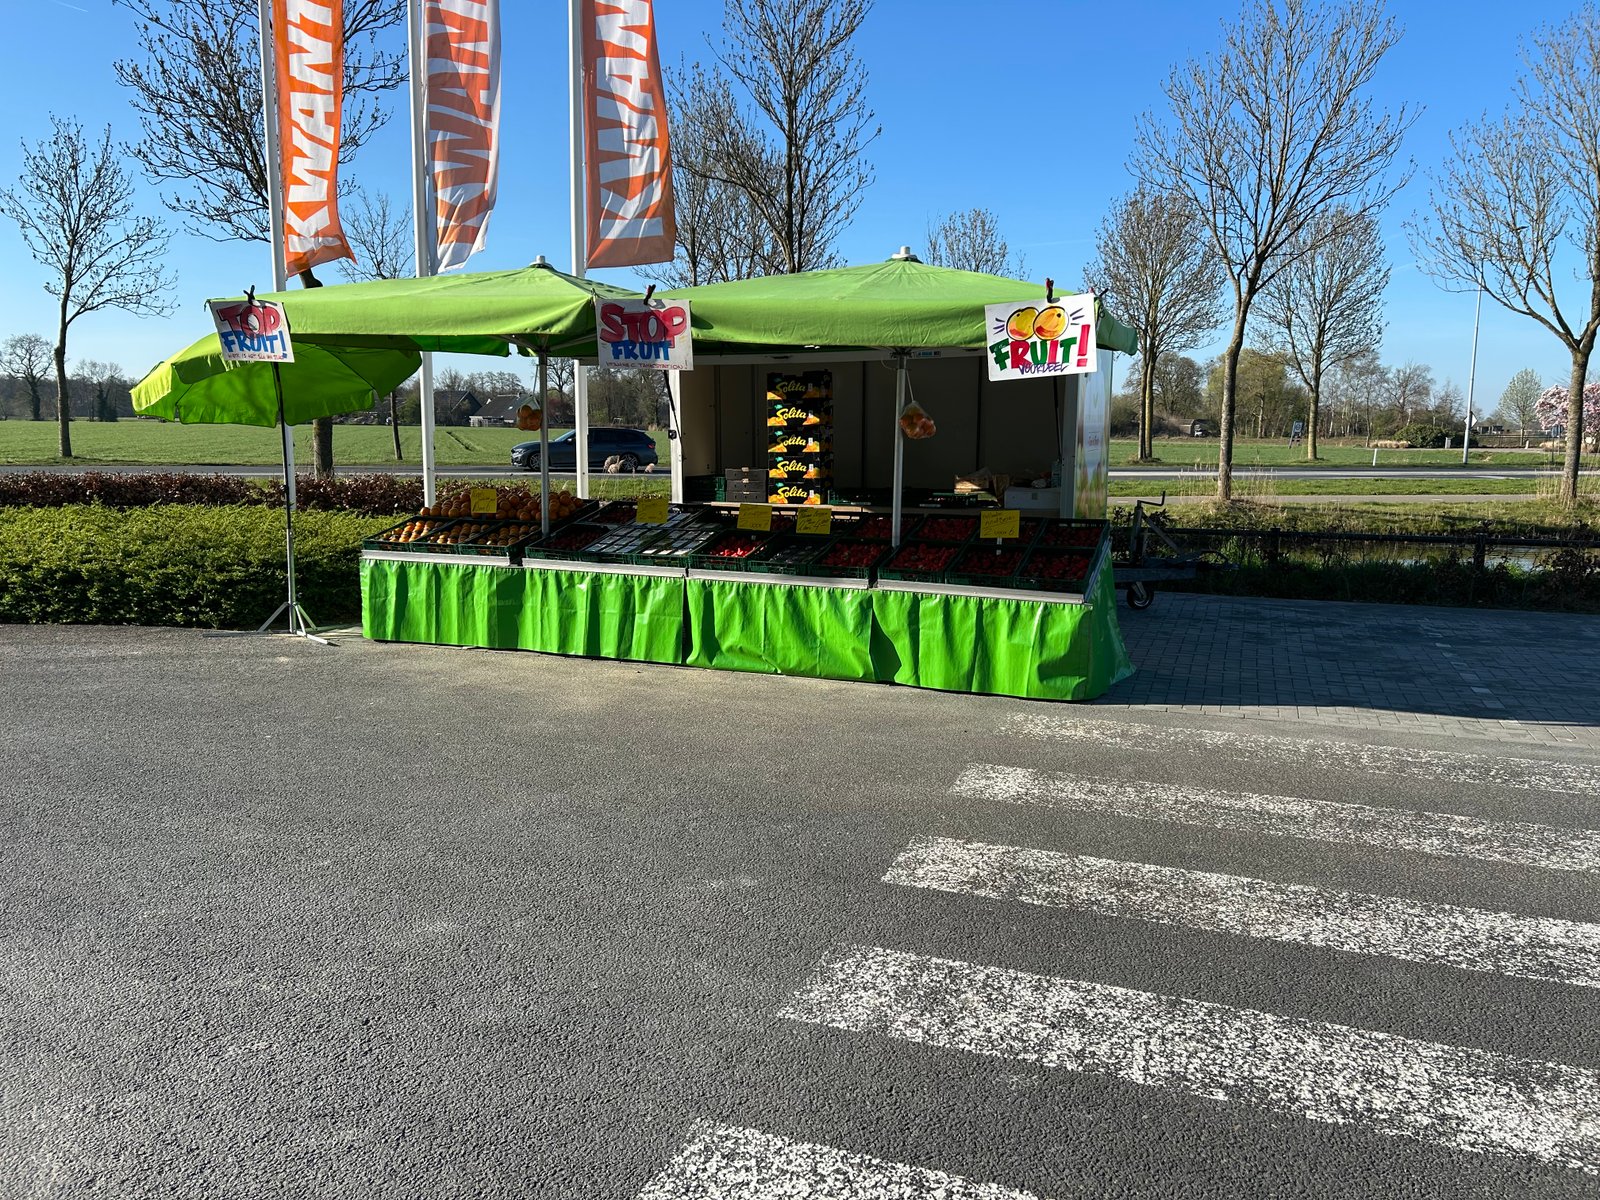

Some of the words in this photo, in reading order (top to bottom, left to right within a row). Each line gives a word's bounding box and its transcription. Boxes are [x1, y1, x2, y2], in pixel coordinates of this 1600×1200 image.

[216, 304, 281, 339] TOP
[600, 303, 687, 348] STOP
[220, 330, 288, 359] FRUIT!
[611, 340, 673, 361] FRUIT
[988, 324, 1091, 372] FRUIT!
[1018, 362, 1069, 375] VOORDEEL
[775, 380, 806, 395] Solita
[776, 407, 807, 422] Solita
[776, 434, 807, 449] Solita
[777, 460, 807, 474] Solita
[777, 486, 808, 499] Solita
